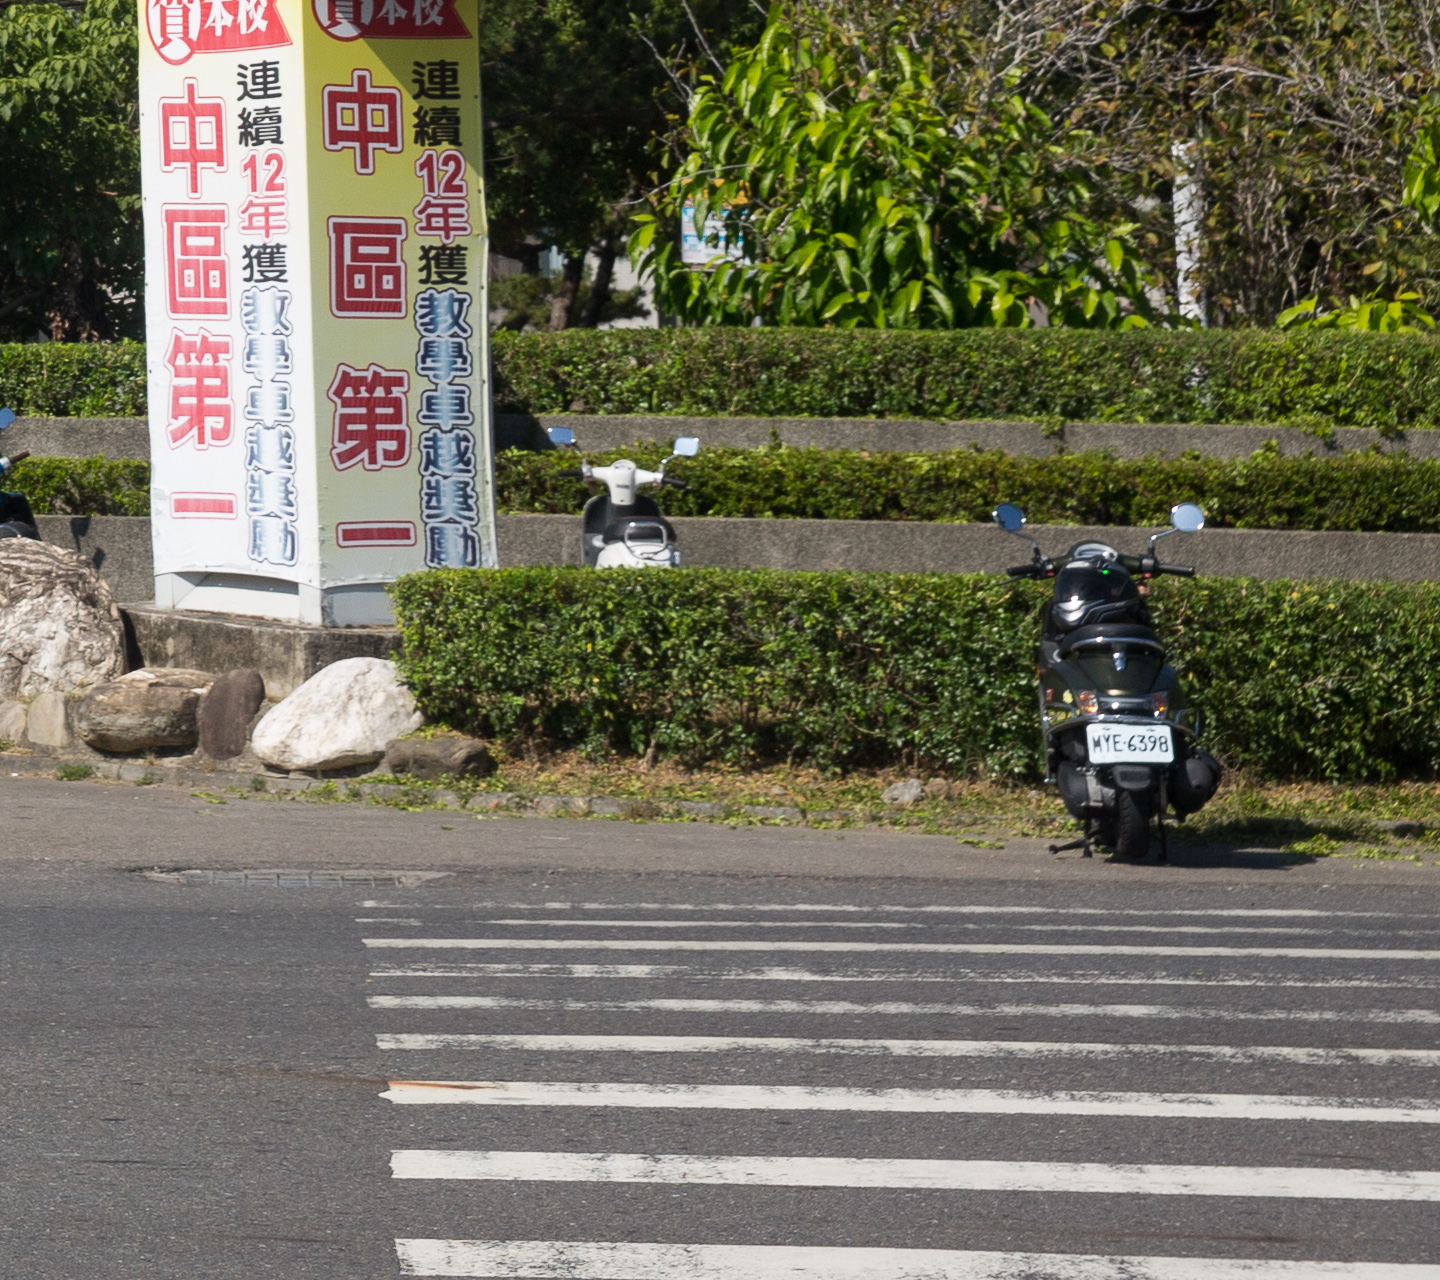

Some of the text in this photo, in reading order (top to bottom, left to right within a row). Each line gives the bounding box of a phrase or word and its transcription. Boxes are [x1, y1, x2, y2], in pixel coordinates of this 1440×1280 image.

[158, 77, 238, 519] 中區第一
[322, 68, 417, 548] 中區第一
[1092, 734, 1169, 753] MYE-6398
